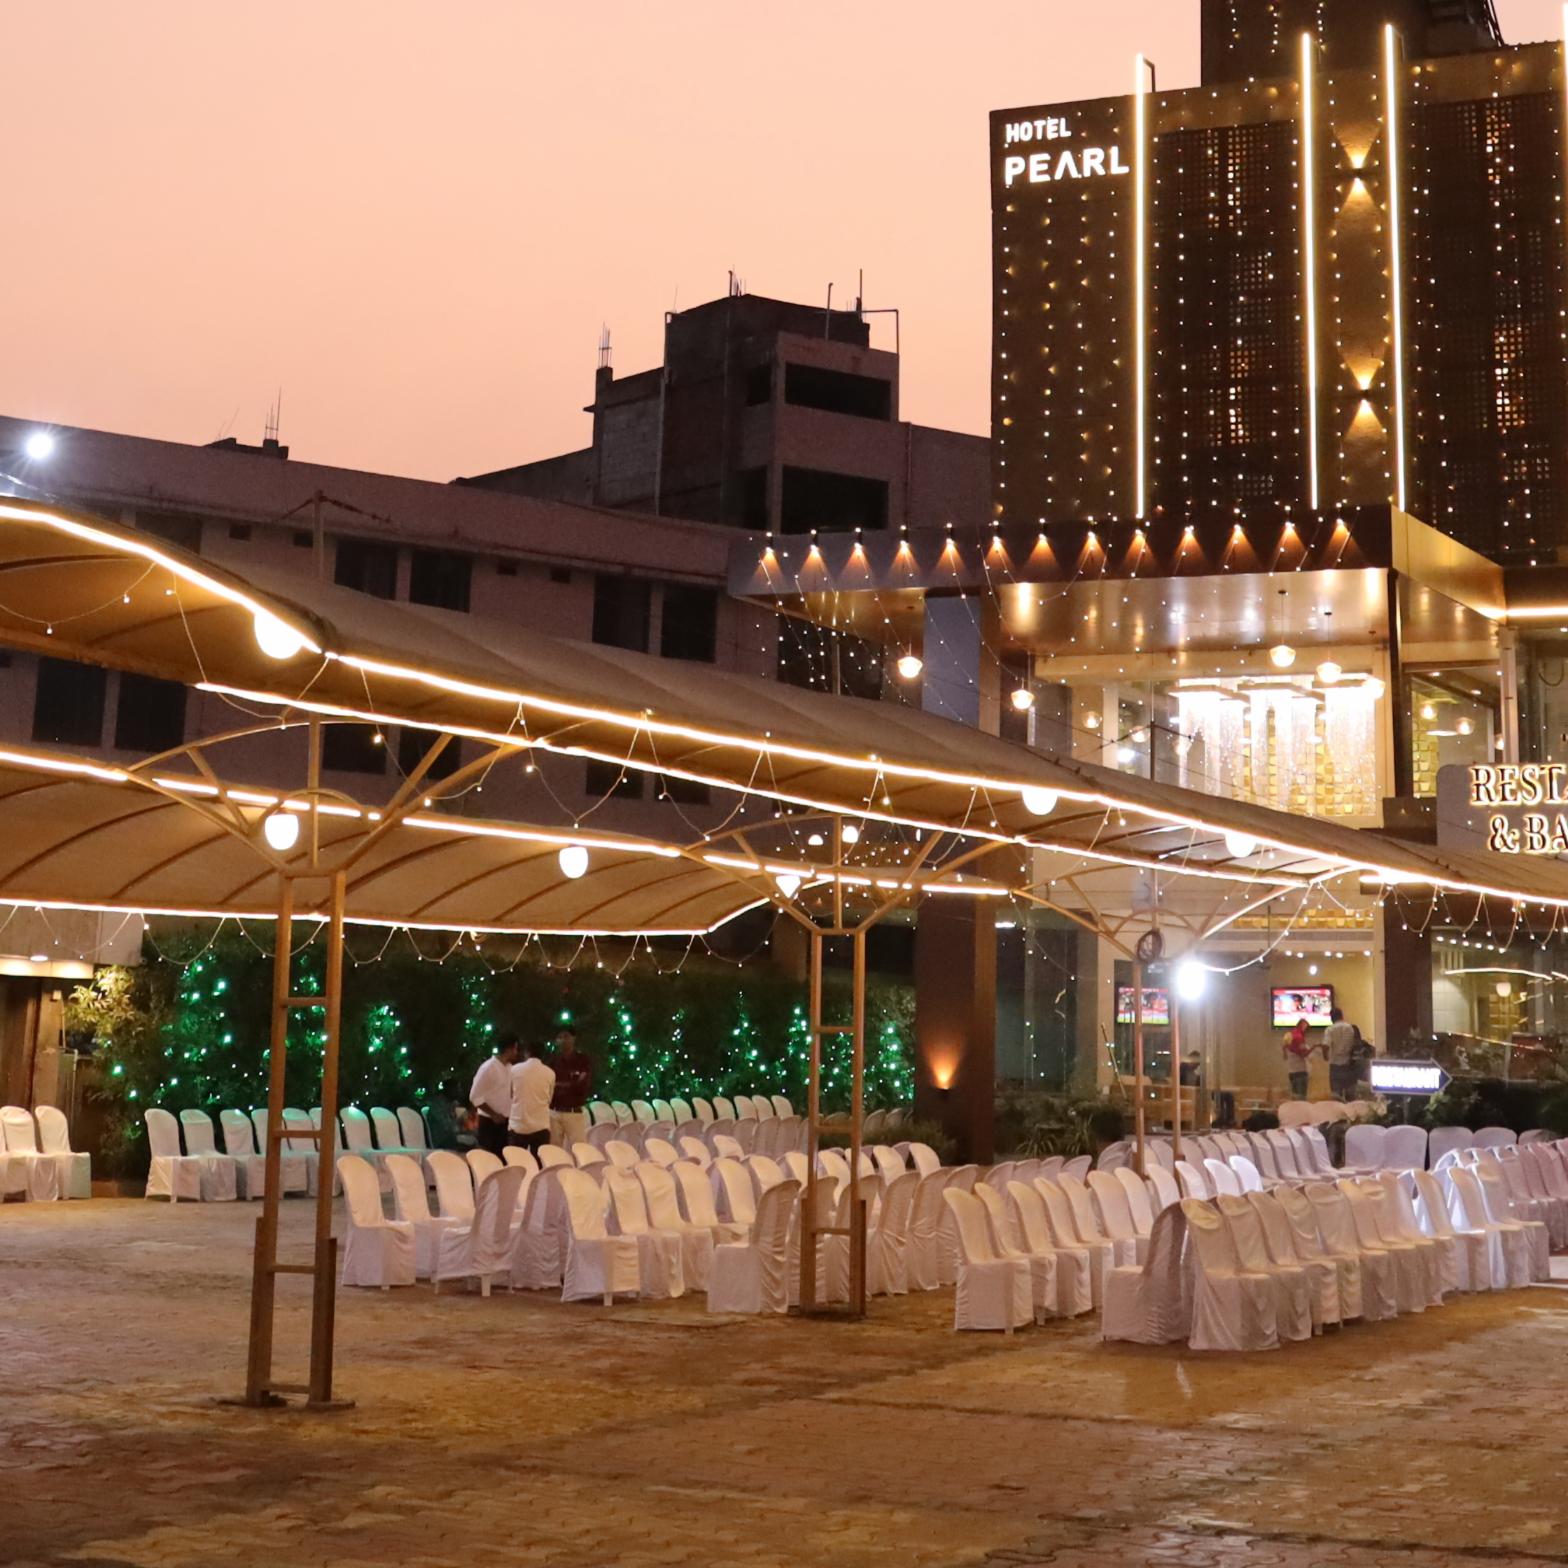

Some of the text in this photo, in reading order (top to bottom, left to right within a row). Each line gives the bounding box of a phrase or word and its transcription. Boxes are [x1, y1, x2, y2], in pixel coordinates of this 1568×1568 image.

[1005, 118, 1072, 144] HOTEL
[1005, 146, 1130, 186] PEARL
[1488, 814, 1520, 853] &
